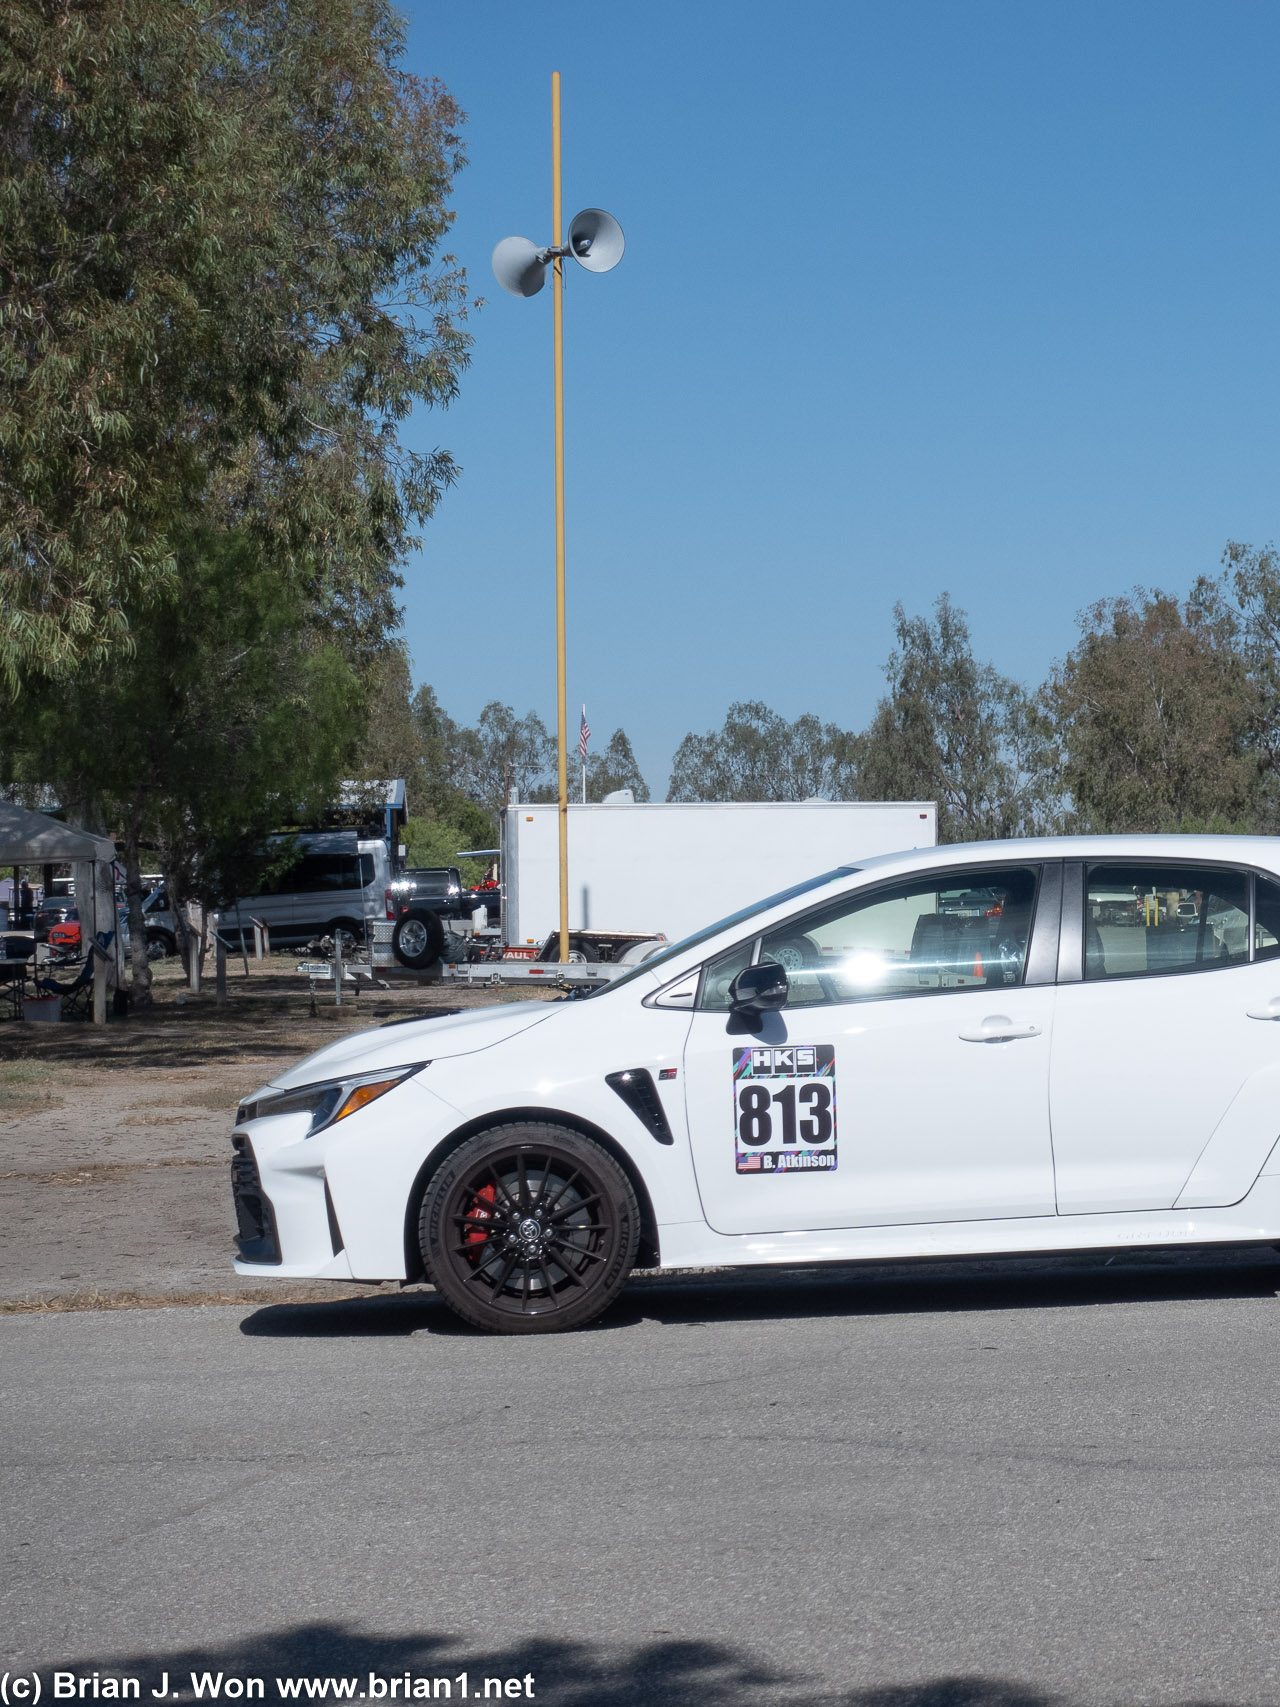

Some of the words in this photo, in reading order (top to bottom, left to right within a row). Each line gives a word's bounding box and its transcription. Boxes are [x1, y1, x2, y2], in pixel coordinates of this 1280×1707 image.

[753, 1048, 815, 1068] HKS
[738, 1083, 832, 1146] 813
[763, 1155, 776, 1169] B.
[778, 1154, 835, 1169] Atkinson
